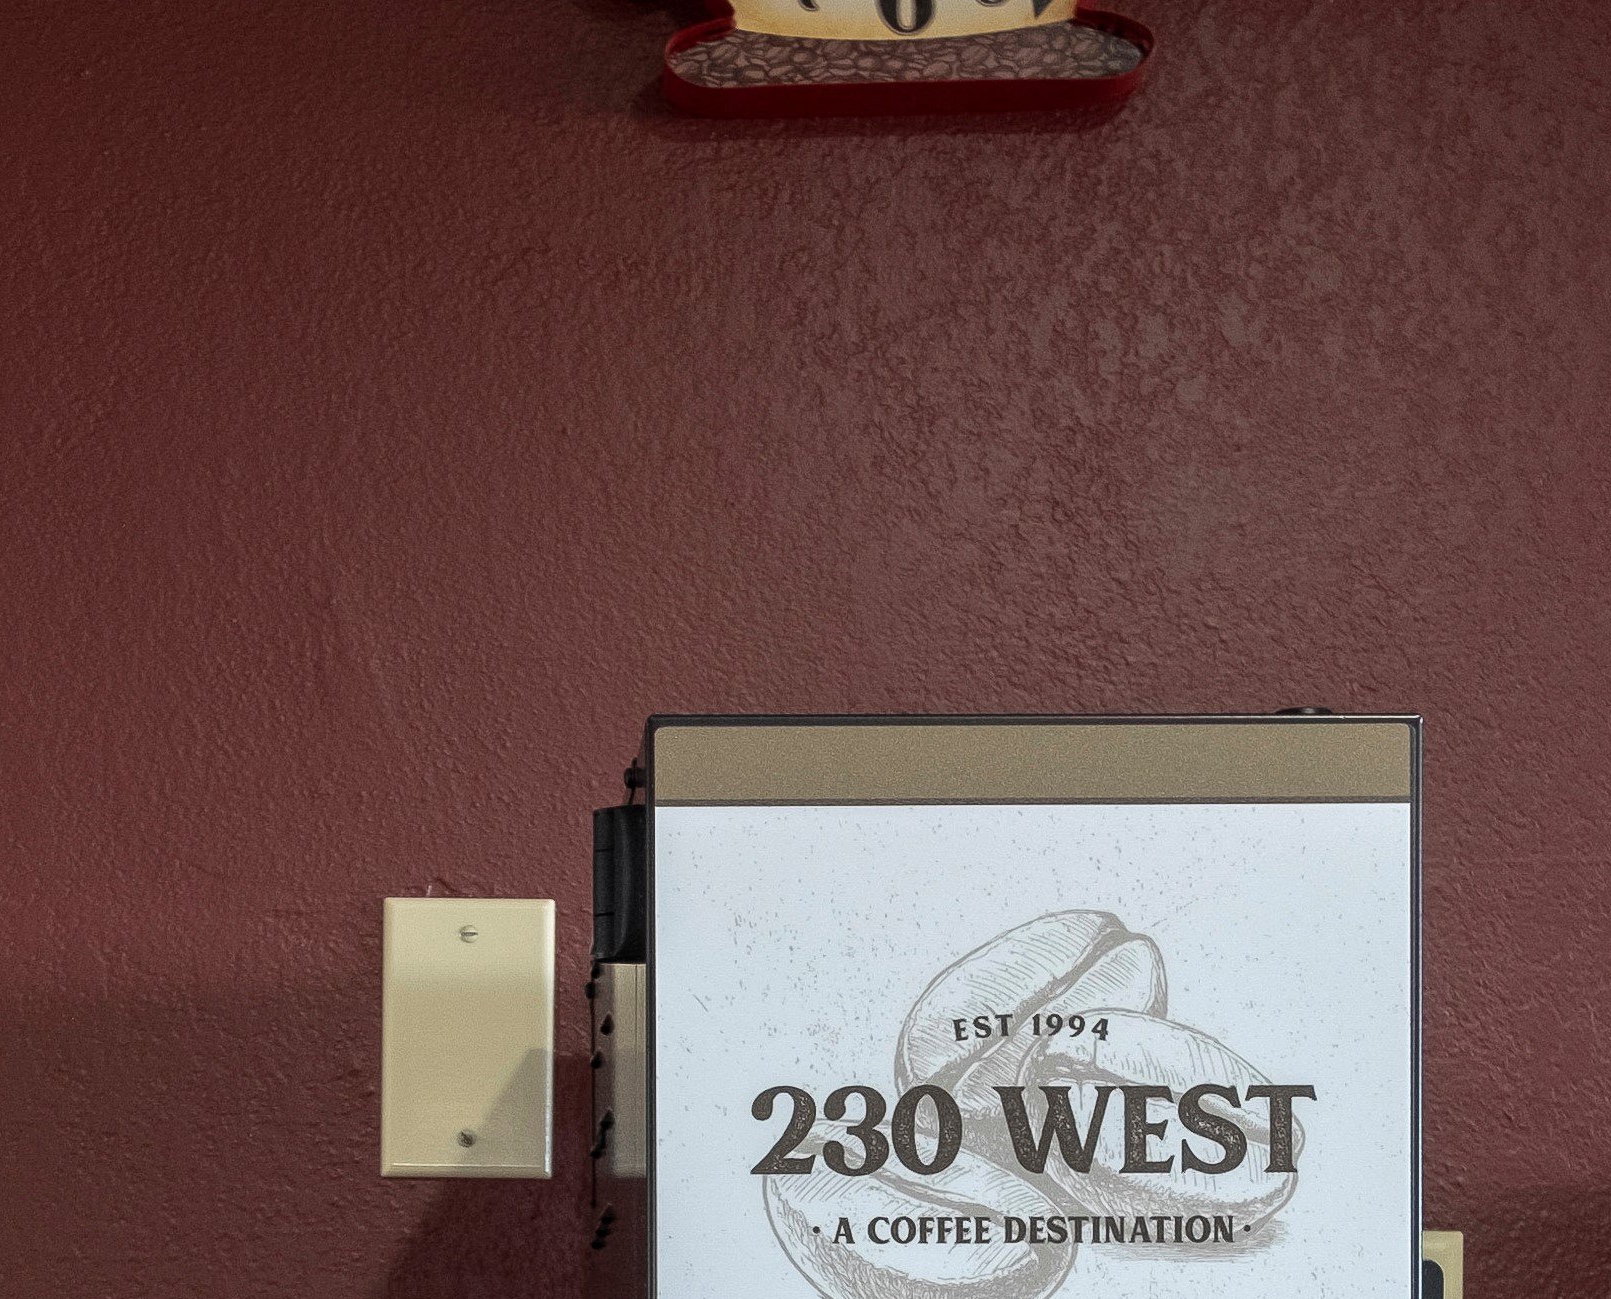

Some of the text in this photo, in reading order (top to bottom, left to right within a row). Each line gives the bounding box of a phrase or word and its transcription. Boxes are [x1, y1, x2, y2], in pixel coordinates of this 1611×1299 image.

[952, 1012, 1110, 1043] EST 1994
[749, 1083, 1318, 1177] 230 WEST
[831, 1215, 1236, 1246] A COFFEE DESTINATION
